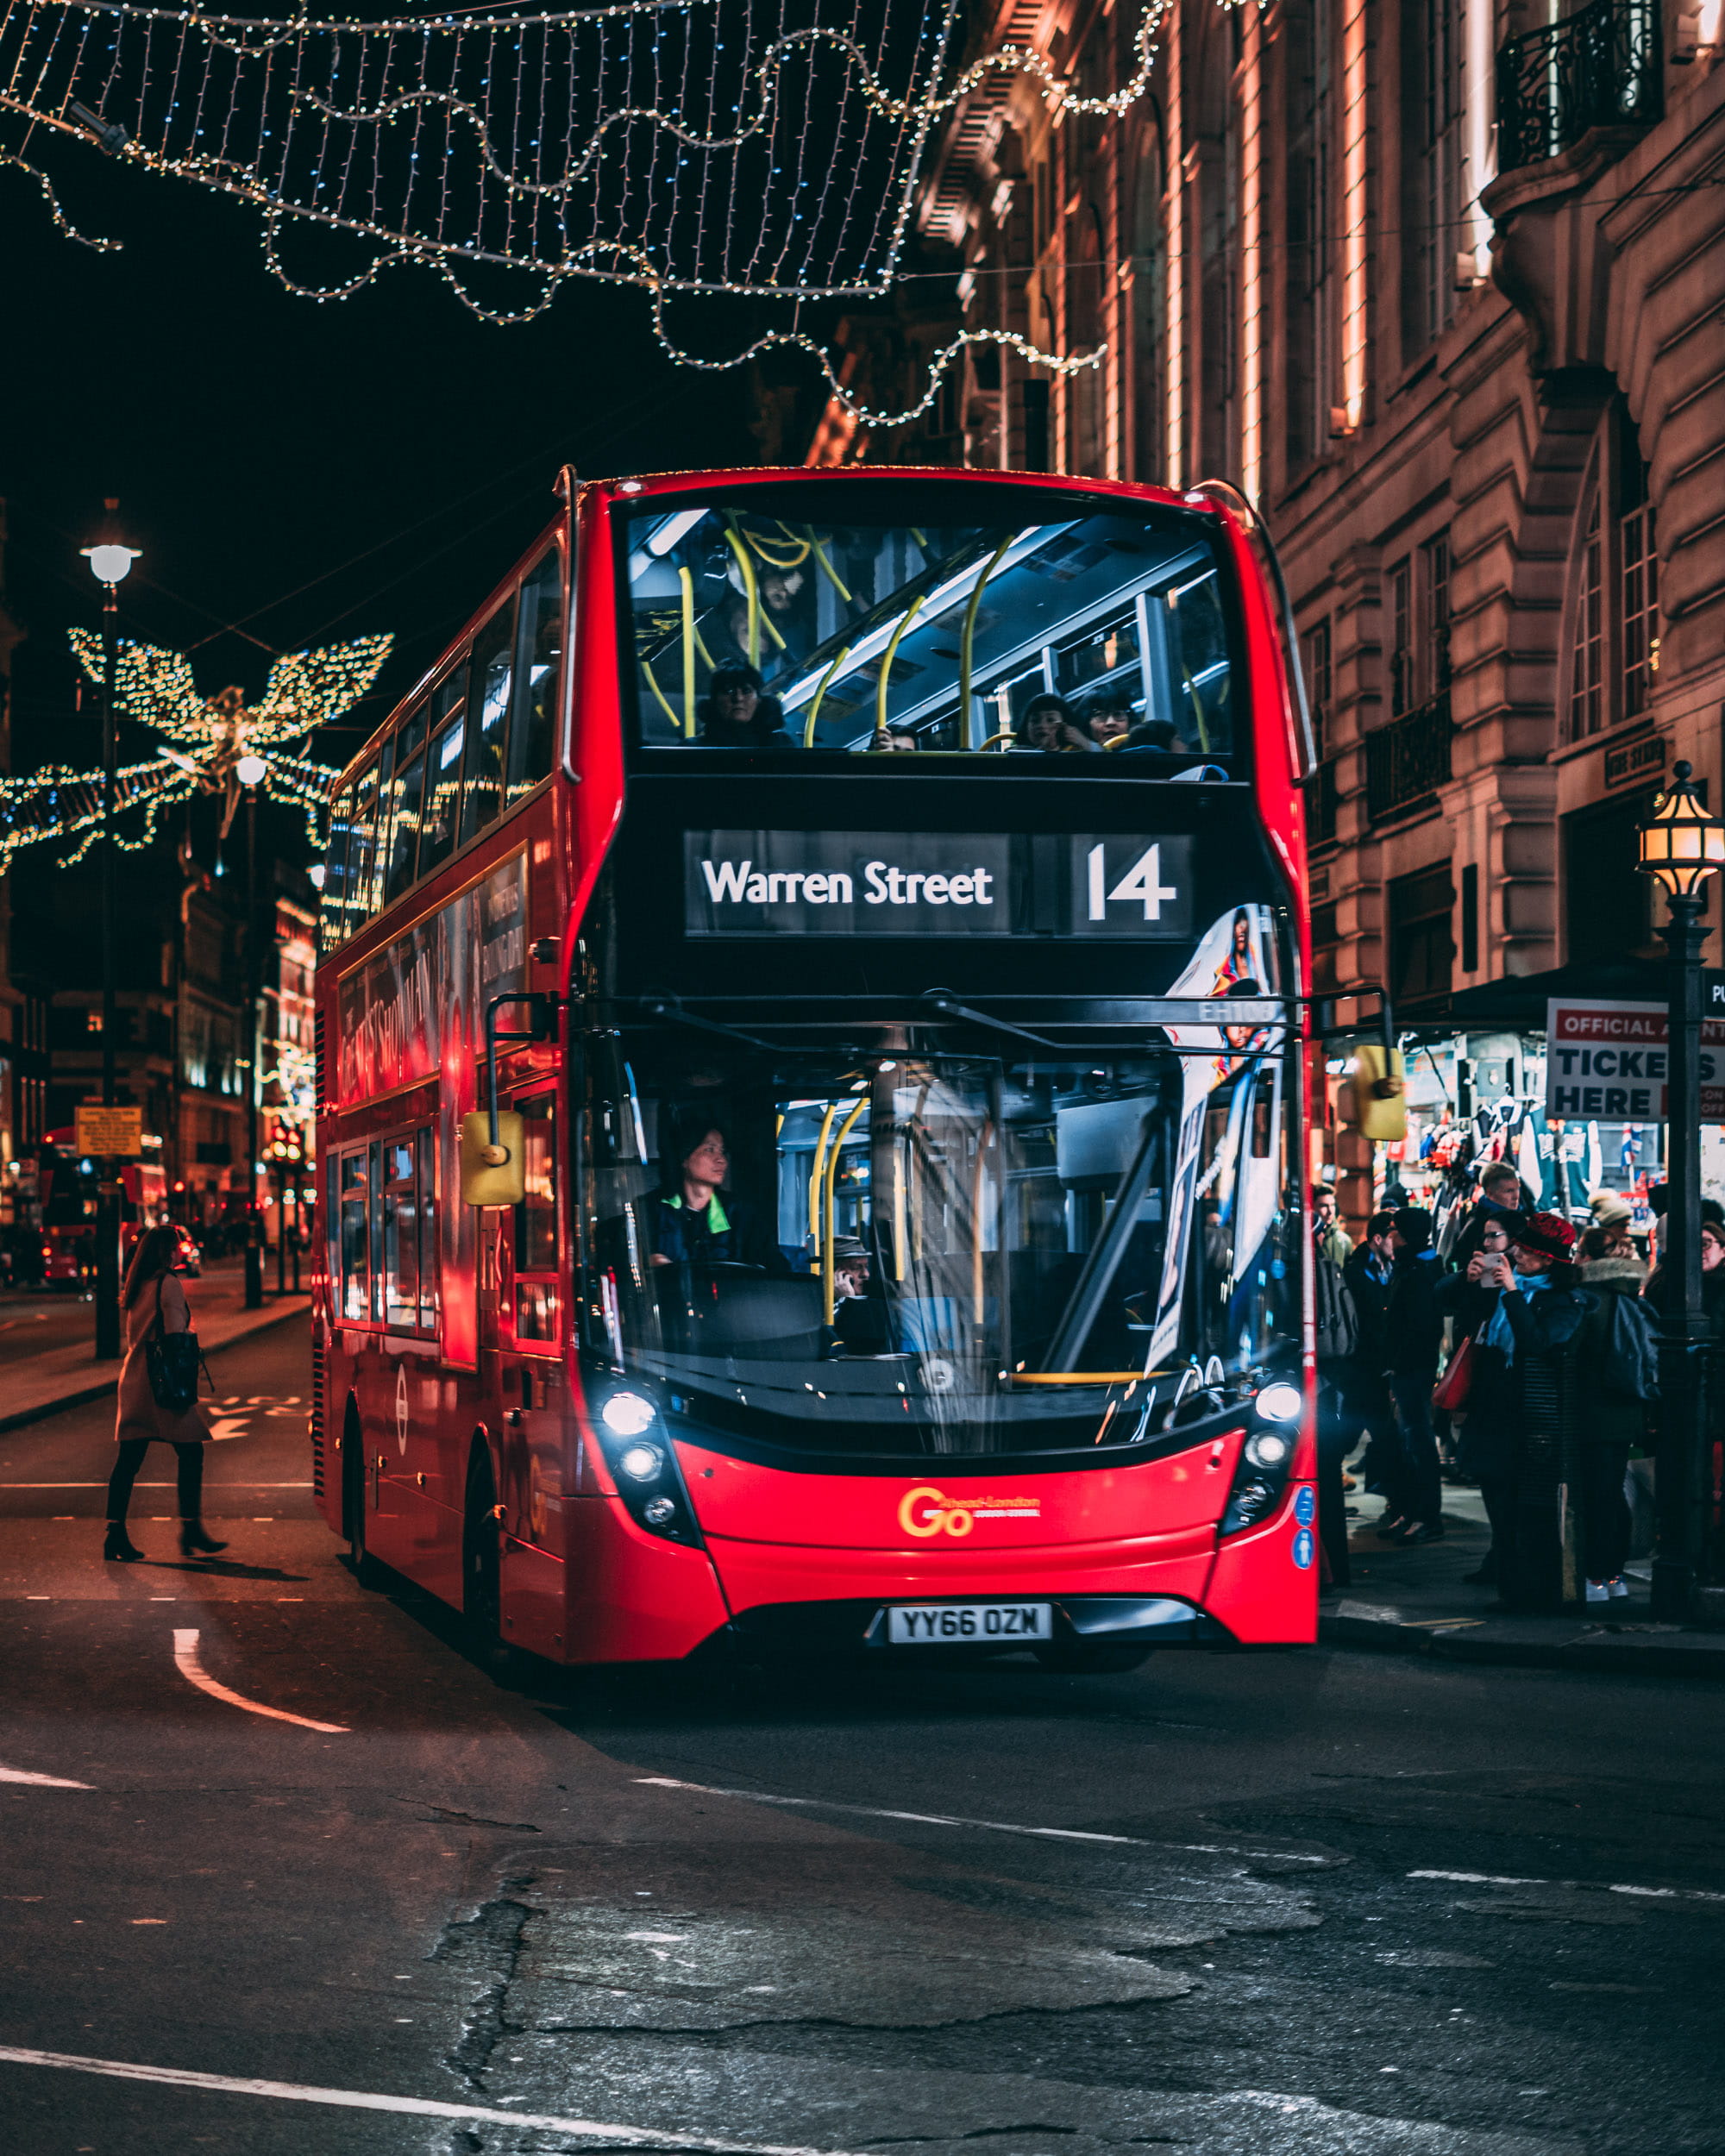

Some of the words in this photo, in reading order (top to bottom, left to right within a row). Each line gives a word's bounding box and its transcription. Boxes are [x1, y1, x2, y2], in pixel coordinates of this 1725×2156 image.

[701, 861, 852, 904] Warren
[863, 862, 993, 904] Street
[1088, 843, 1176, 921] 14
[1564, 1016, 1656, 1036] OFFICIAL
[1555, 1048, 1716, 1081] TICKES
[1554, 1085, 1651, 1116] HERE
[897, 1486, 974, 1538] Go
[902, 1609, 977, 1638] YY66
